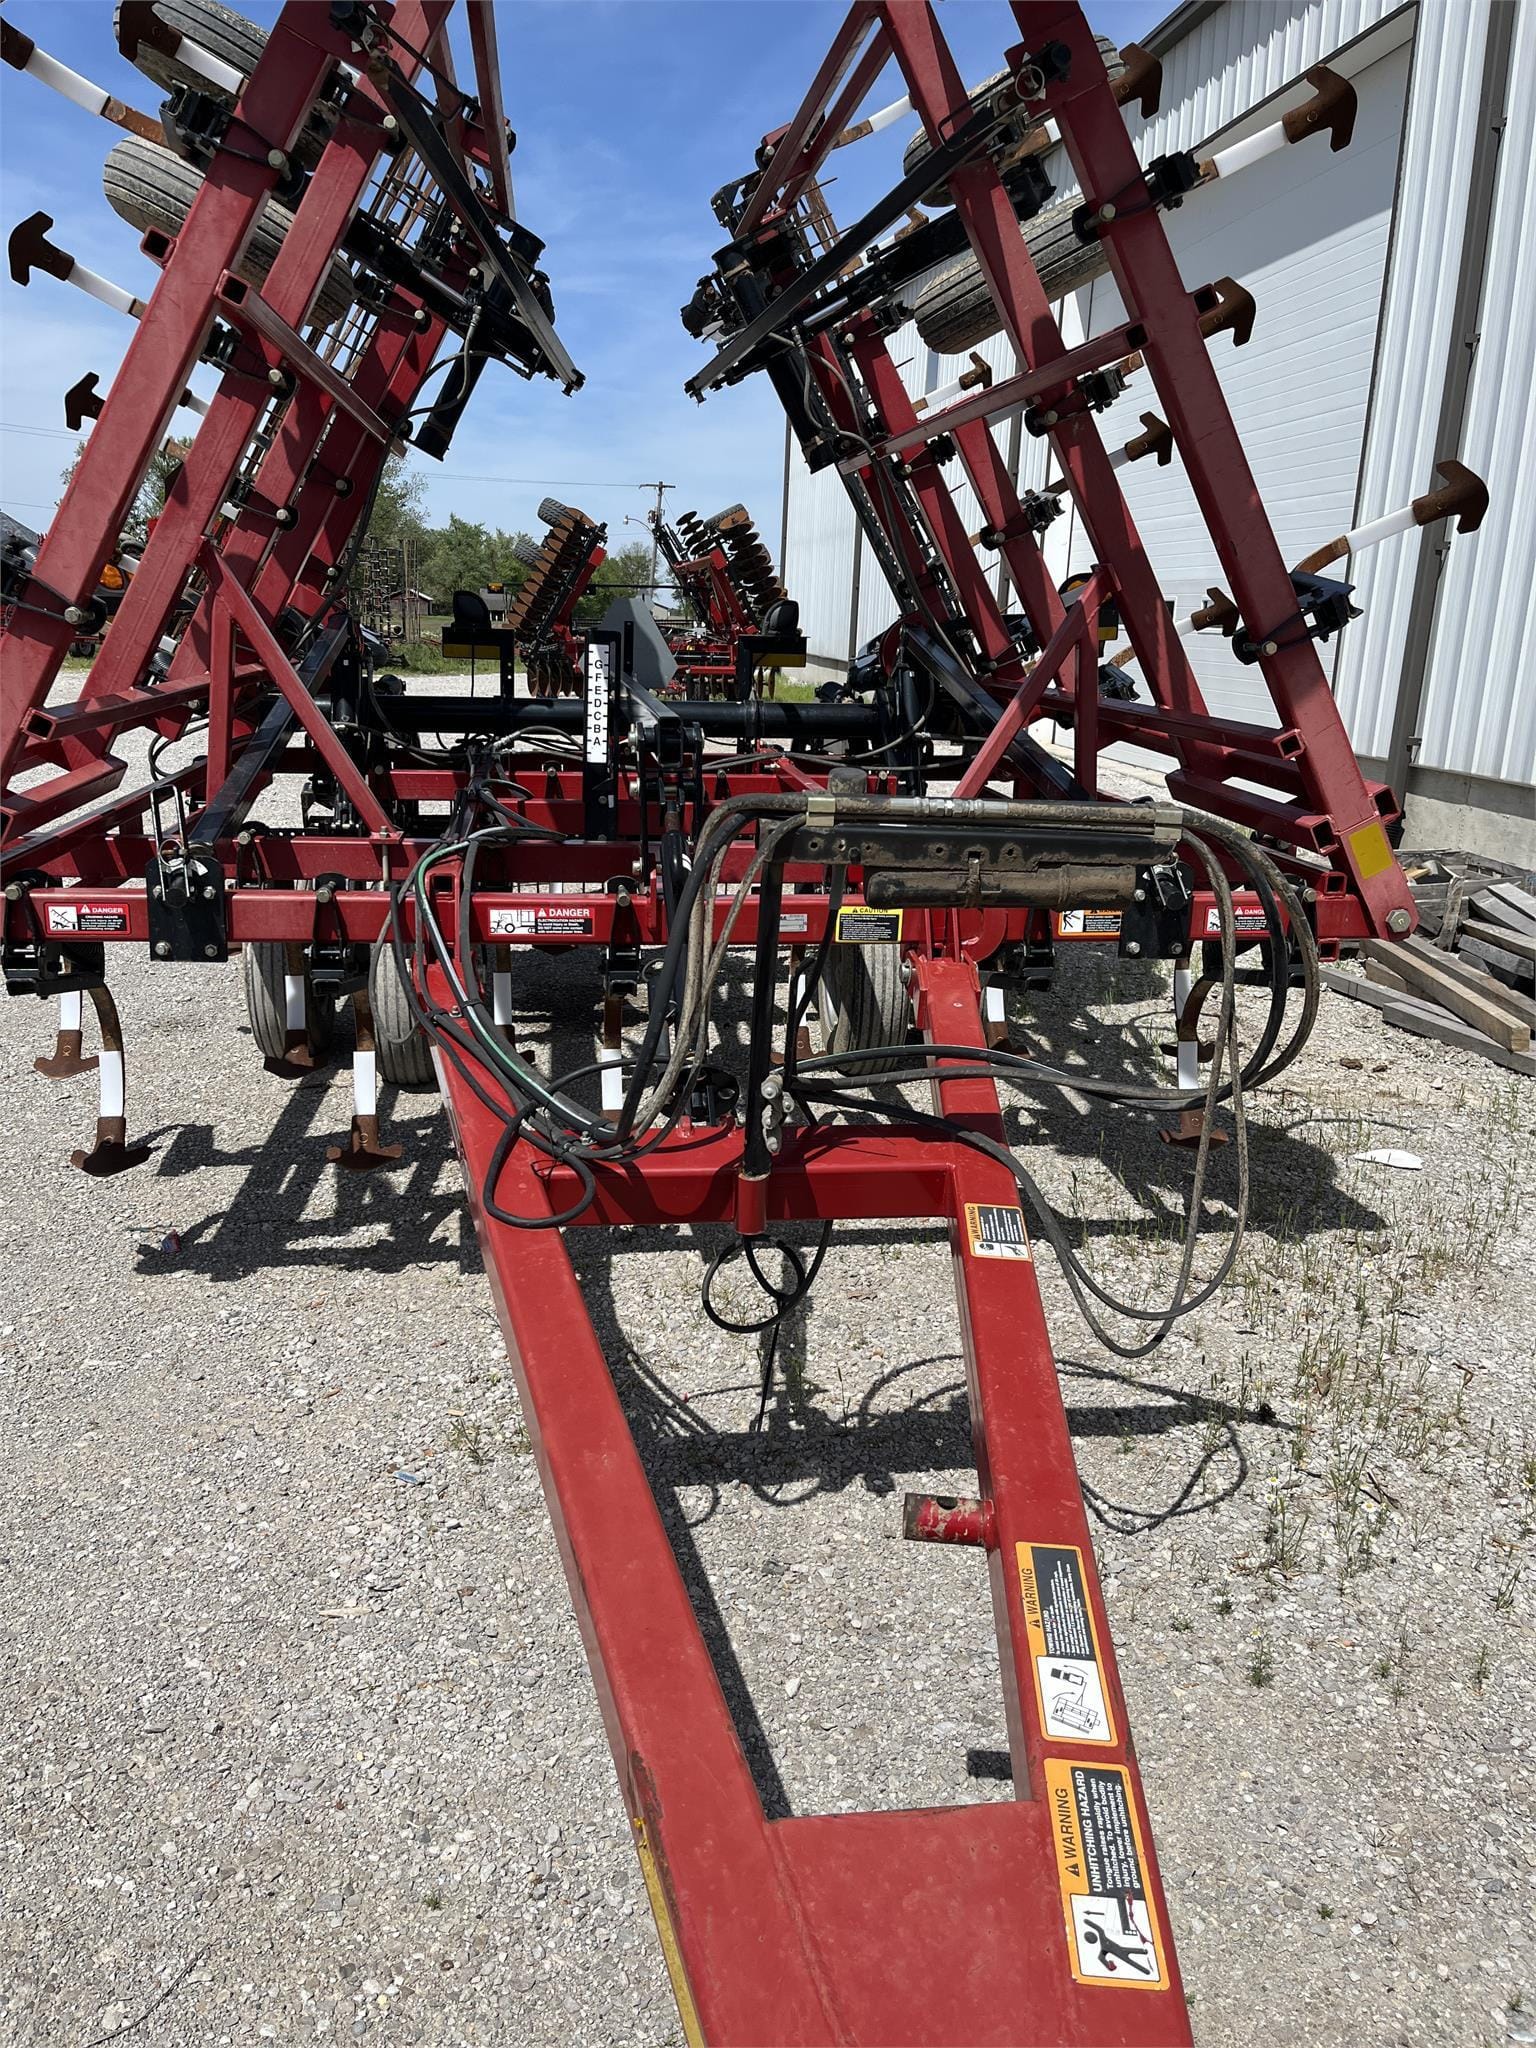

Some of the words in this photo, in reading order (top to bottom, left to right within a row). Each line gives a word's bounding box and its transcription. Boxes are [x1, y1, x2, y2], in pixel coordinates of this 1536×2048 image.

[549, 908, 590, 916] DANGER
[968, 1206, 978, 1234] WARNING
[1022, 1568, 1042, 1614] WARNING
[1075, 1770, 1090, 1816] HAZARD
[1099, 1780, 1107, 1804] bodily
[1107, 1783, 1113, 1792] to
[1094, 1801, 1104, 1828] rapidly
[1102, 1806, 1111, 1829] avoid
[1109, 1795, 1121, 1834] implement
[1115, 1784, 1128, 1827] unhitching.
[1056, 1788, 1077, 1859] WARNING
[1107, 1831, 1113, 1840] To
[1083, 1820, 1102, 1892] UNHITCHING
[1099, 1830, 1108, 1856] raises
[1117, 1836, 1125, 1859] lower
[1124, 1829, 1133, 1856] before
[1104, 1858, 1114, 1889] Tongue
[1109, 1844, 1122, 1888] unhitched.
[1121, 1862, 1130, 1888] injury,
[1128, 1858, 1140, 1888] ground
